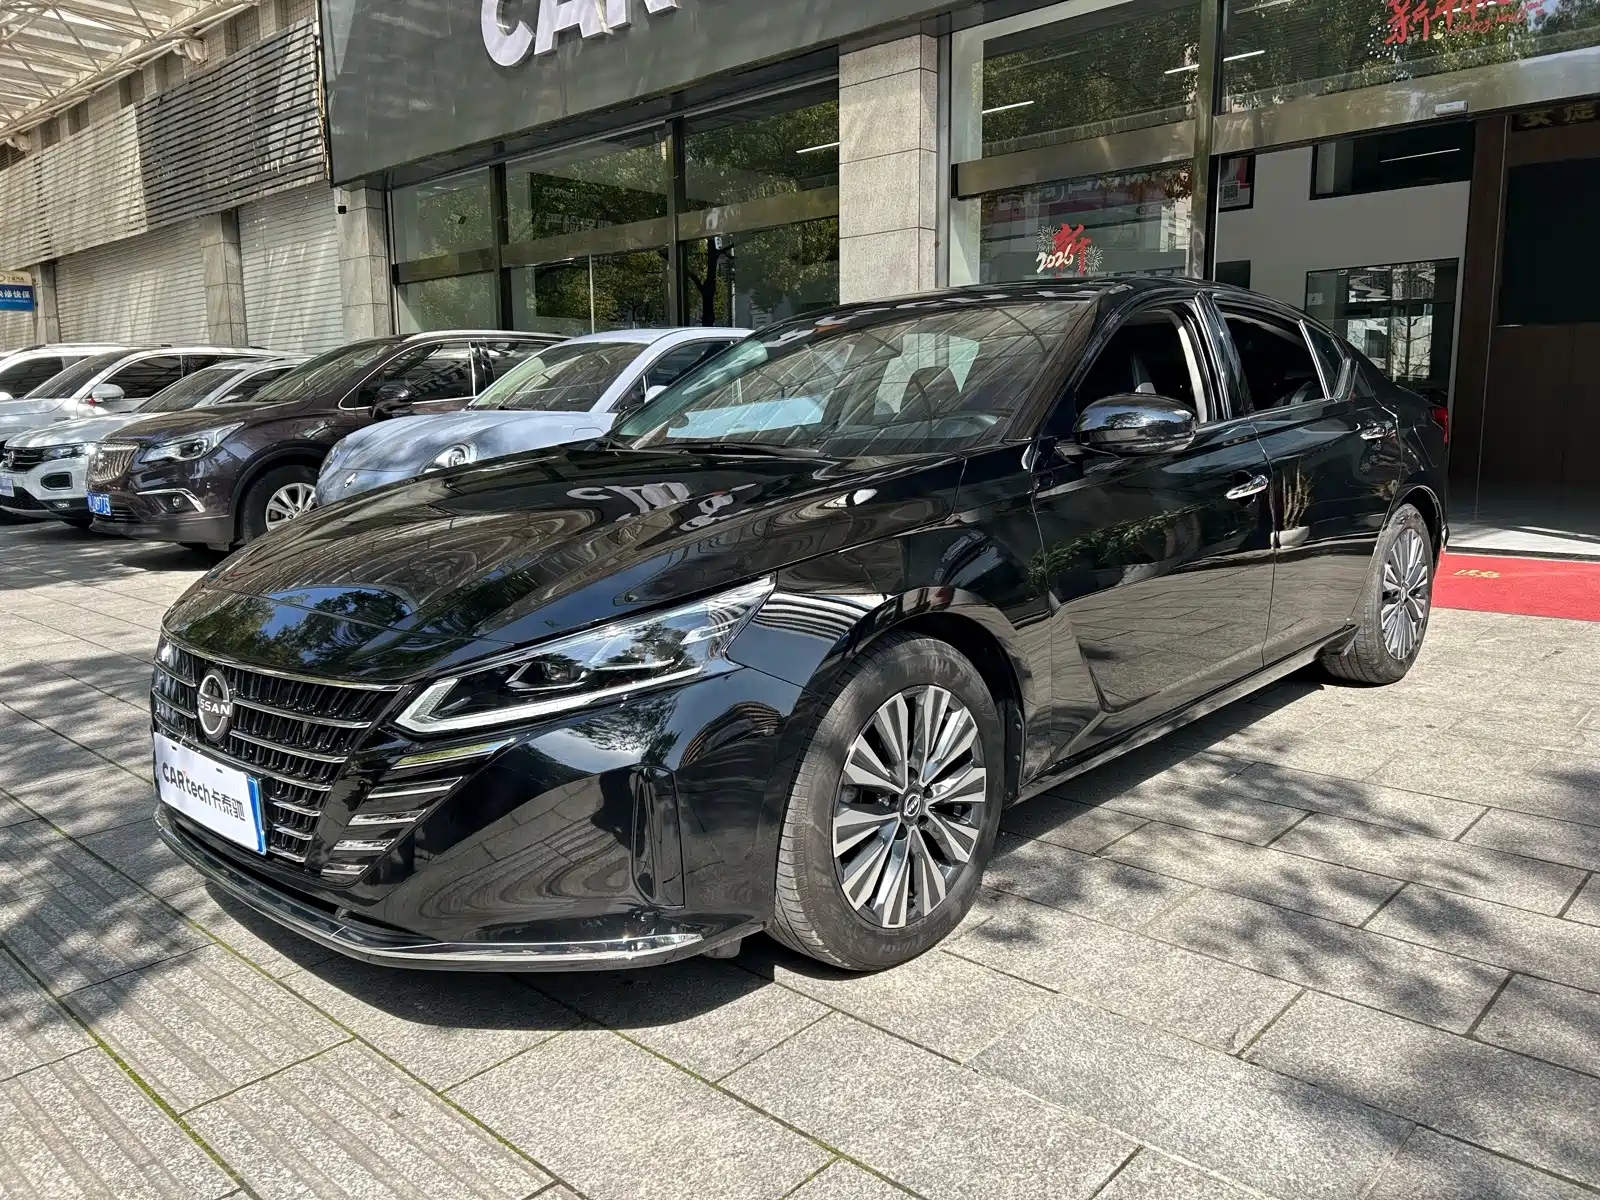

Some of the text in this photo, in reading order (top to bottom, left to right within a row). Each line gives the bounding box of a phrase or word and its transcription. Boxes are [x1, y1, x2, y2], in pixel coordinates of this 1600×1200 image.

[481, 0, 682, 67] CA
[1036, 243, 1074, 274] 2026
[162, 761, 212, 806] CARtech
